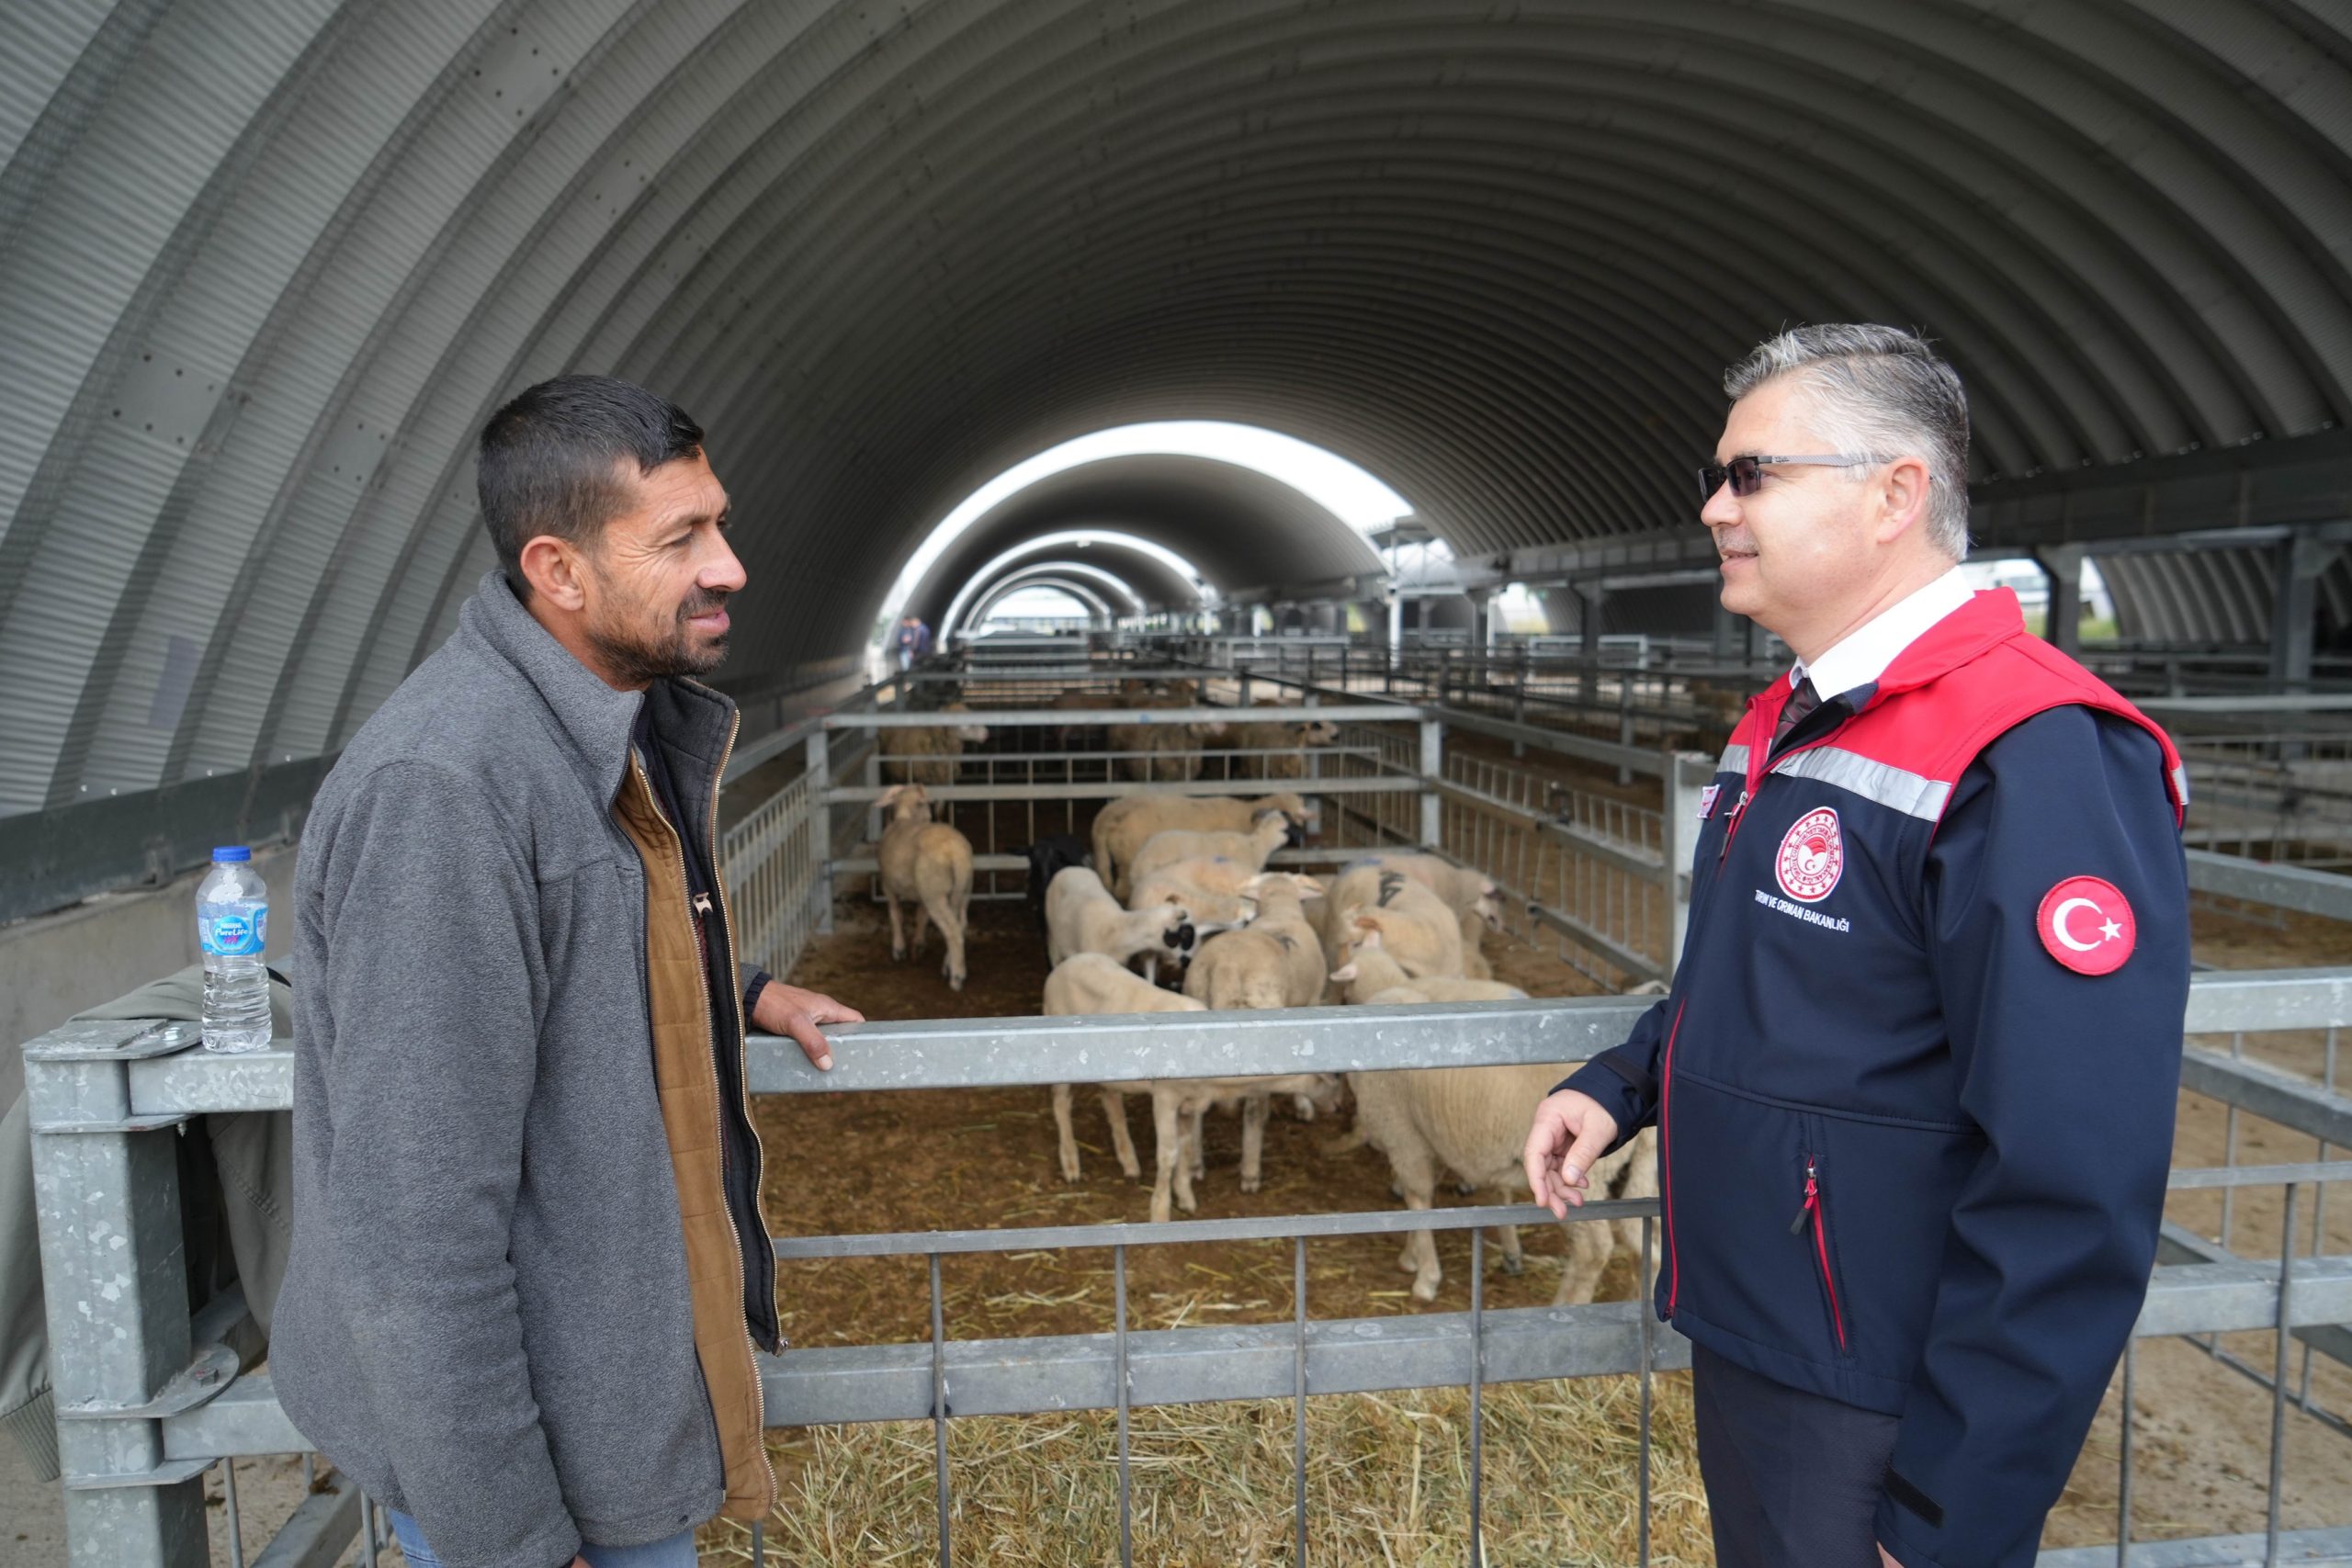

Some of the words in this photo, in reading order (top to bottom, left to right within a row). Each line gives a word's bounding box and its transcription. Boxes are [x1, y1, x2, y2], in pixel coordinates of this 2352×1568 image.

[1768, 895, 1778, 908] VE
[1777, 899, 1804, 919] ORMAN
[1804, 909, 1849, 932] BAKANLIĞI
